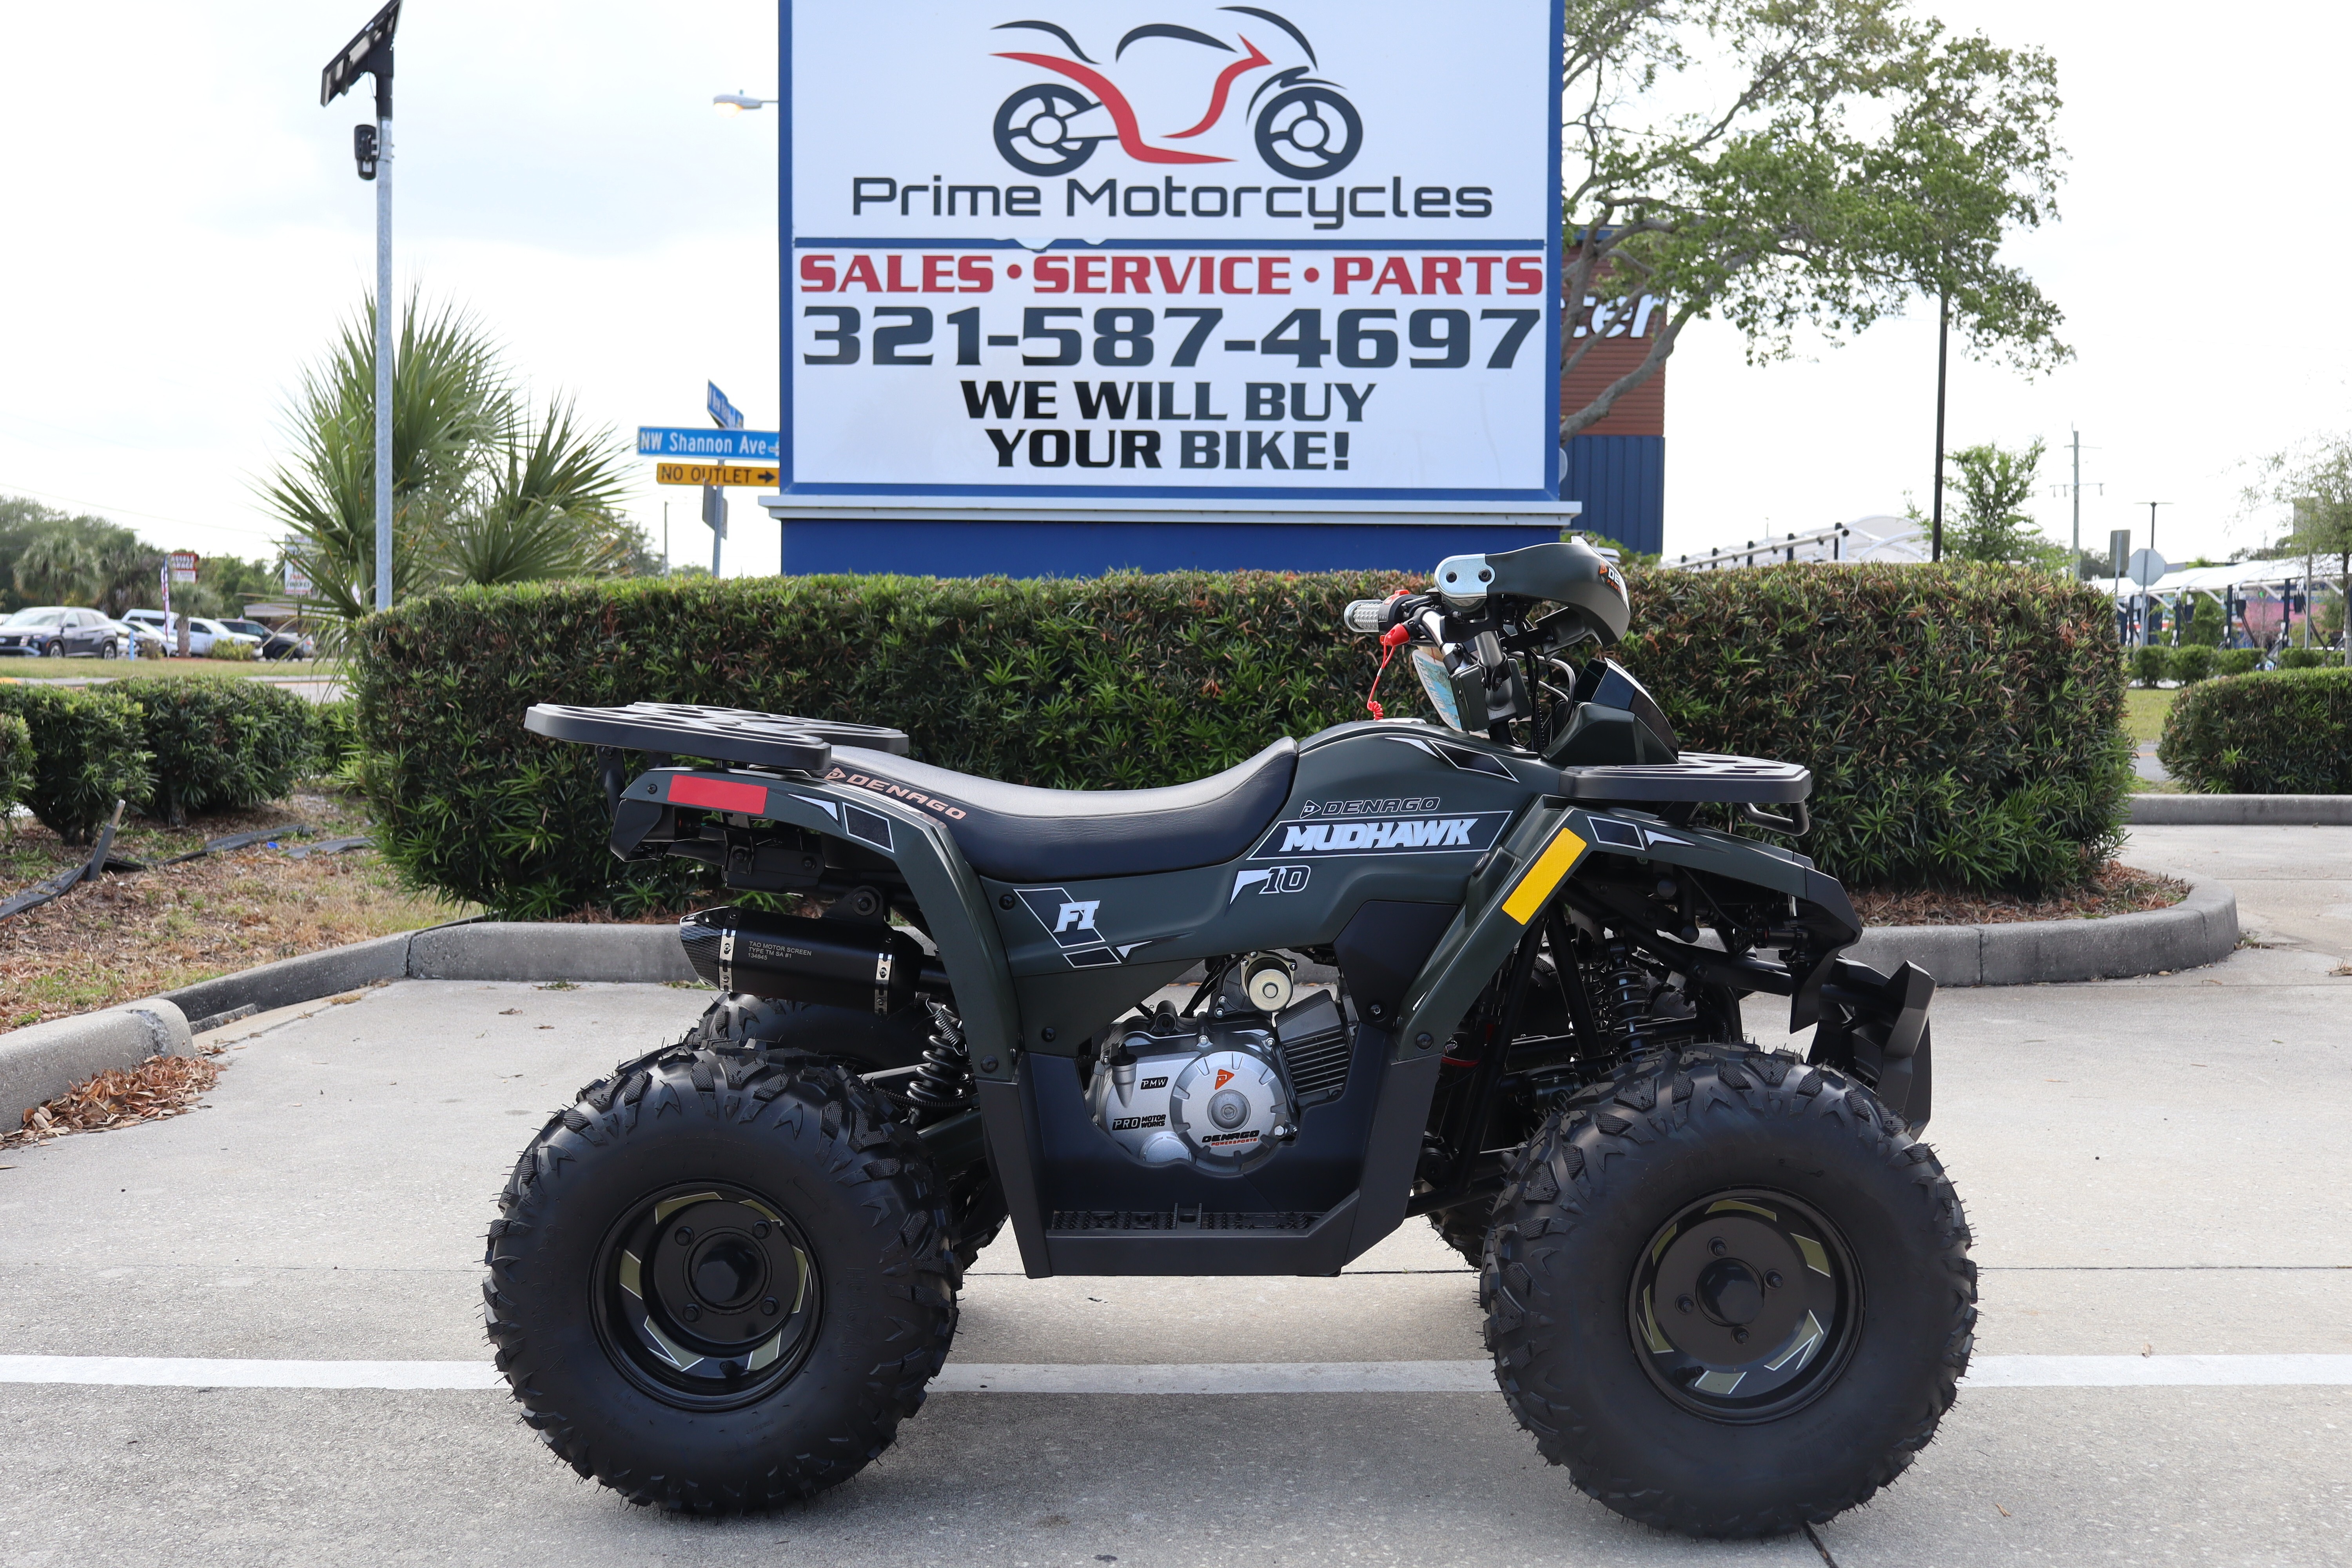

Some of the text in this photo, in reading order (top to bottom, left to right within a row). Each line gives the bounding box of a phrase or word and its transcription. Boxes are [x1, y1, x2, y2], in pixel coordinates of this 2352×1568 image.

[853, 175, 1492, 230] Prime Motorcycles
[800, 255, 1543, 295] SALES SERVICE PARTS
[804, 306, 1541, 369] 321-587-4697
[960, 380, 1377, 422] WE WILL BUY
[640, 431, 767, 455] NW Shannon Ave
[985, 429, 1350, 470] YOUR BIKE!
[662, 465, 752, 483] NO OUTLET
[1415, 657, 1435, 690] SAFETY
[1430, 690, 1446, 710] WITH
[846, 773, 967, 820] DENAGO
[1321, 797, 1441, 816] DENAGO
[1278, 818, 1479, 852] MUDHAWK
[1053, 900, 1101, 933] FI
[748, 952, 768, 960] 134645
[763, 943, 785, 952] MOTOR
[786, 947, 812, 956] SCREEN
[1142, 1078, 1166, 1088] PMW
[1114, 1118, 1139, 1129] PRO
[1201, 1130, 1260, 1143] DENAGO
[1211, 1138, 1258, 1147] POWERSPORTS
